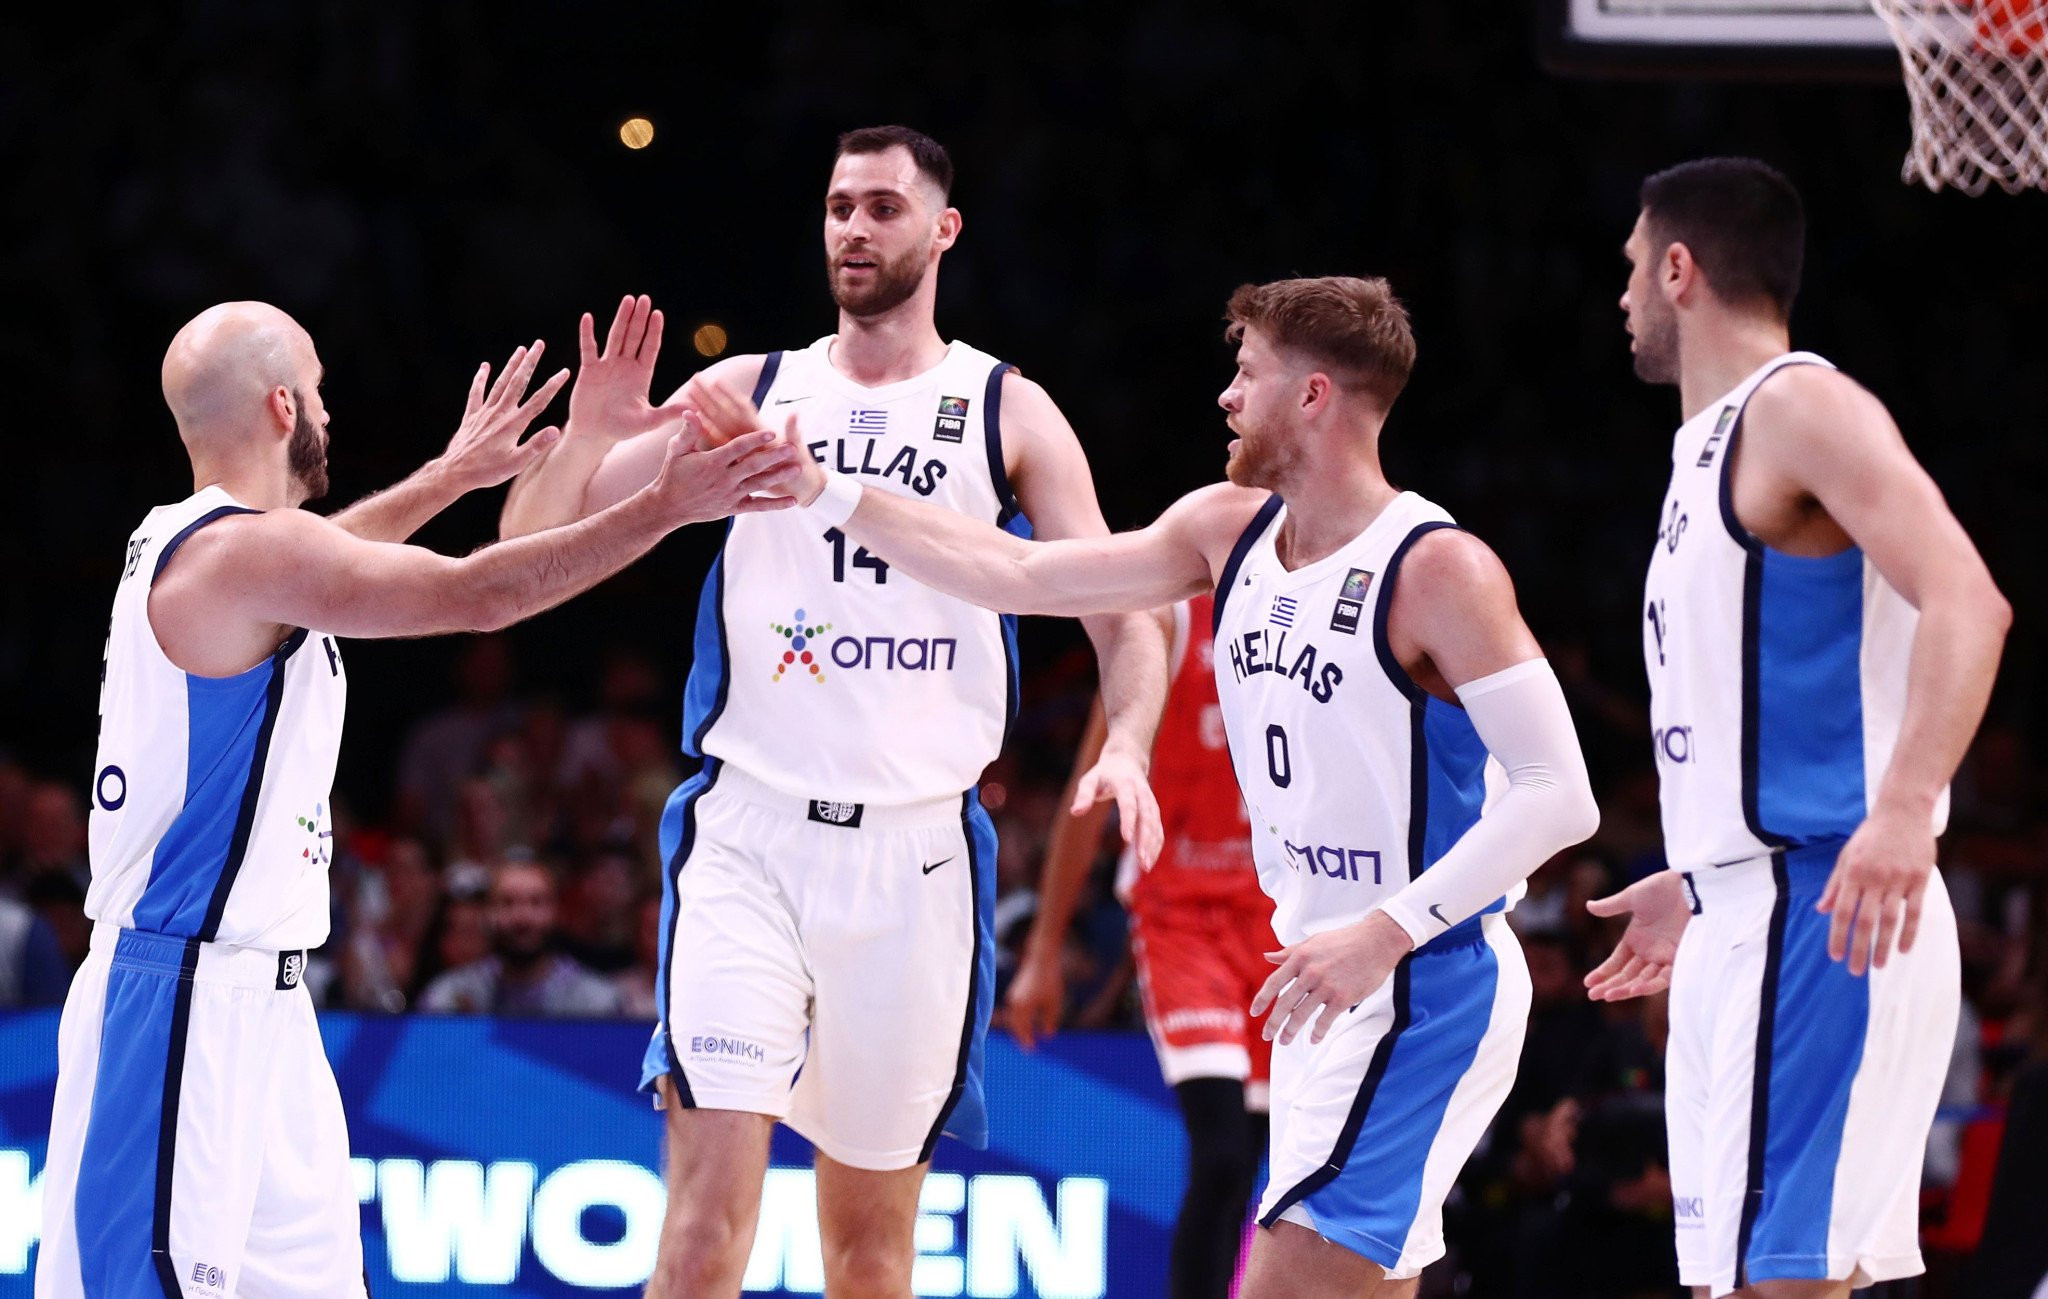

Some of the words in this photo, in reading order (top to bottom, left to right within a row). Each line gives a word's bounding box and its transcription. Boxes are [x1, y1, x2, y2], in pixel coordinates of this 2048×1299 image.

[939, 418, 961, 430] FIBA
[807, 438, 948, 496] ELLAS
[823, 526, 889, 584] 14
[1337, 603, 1359, 618] FIBA
[1229, 628, 1343, 703] HELLAS
